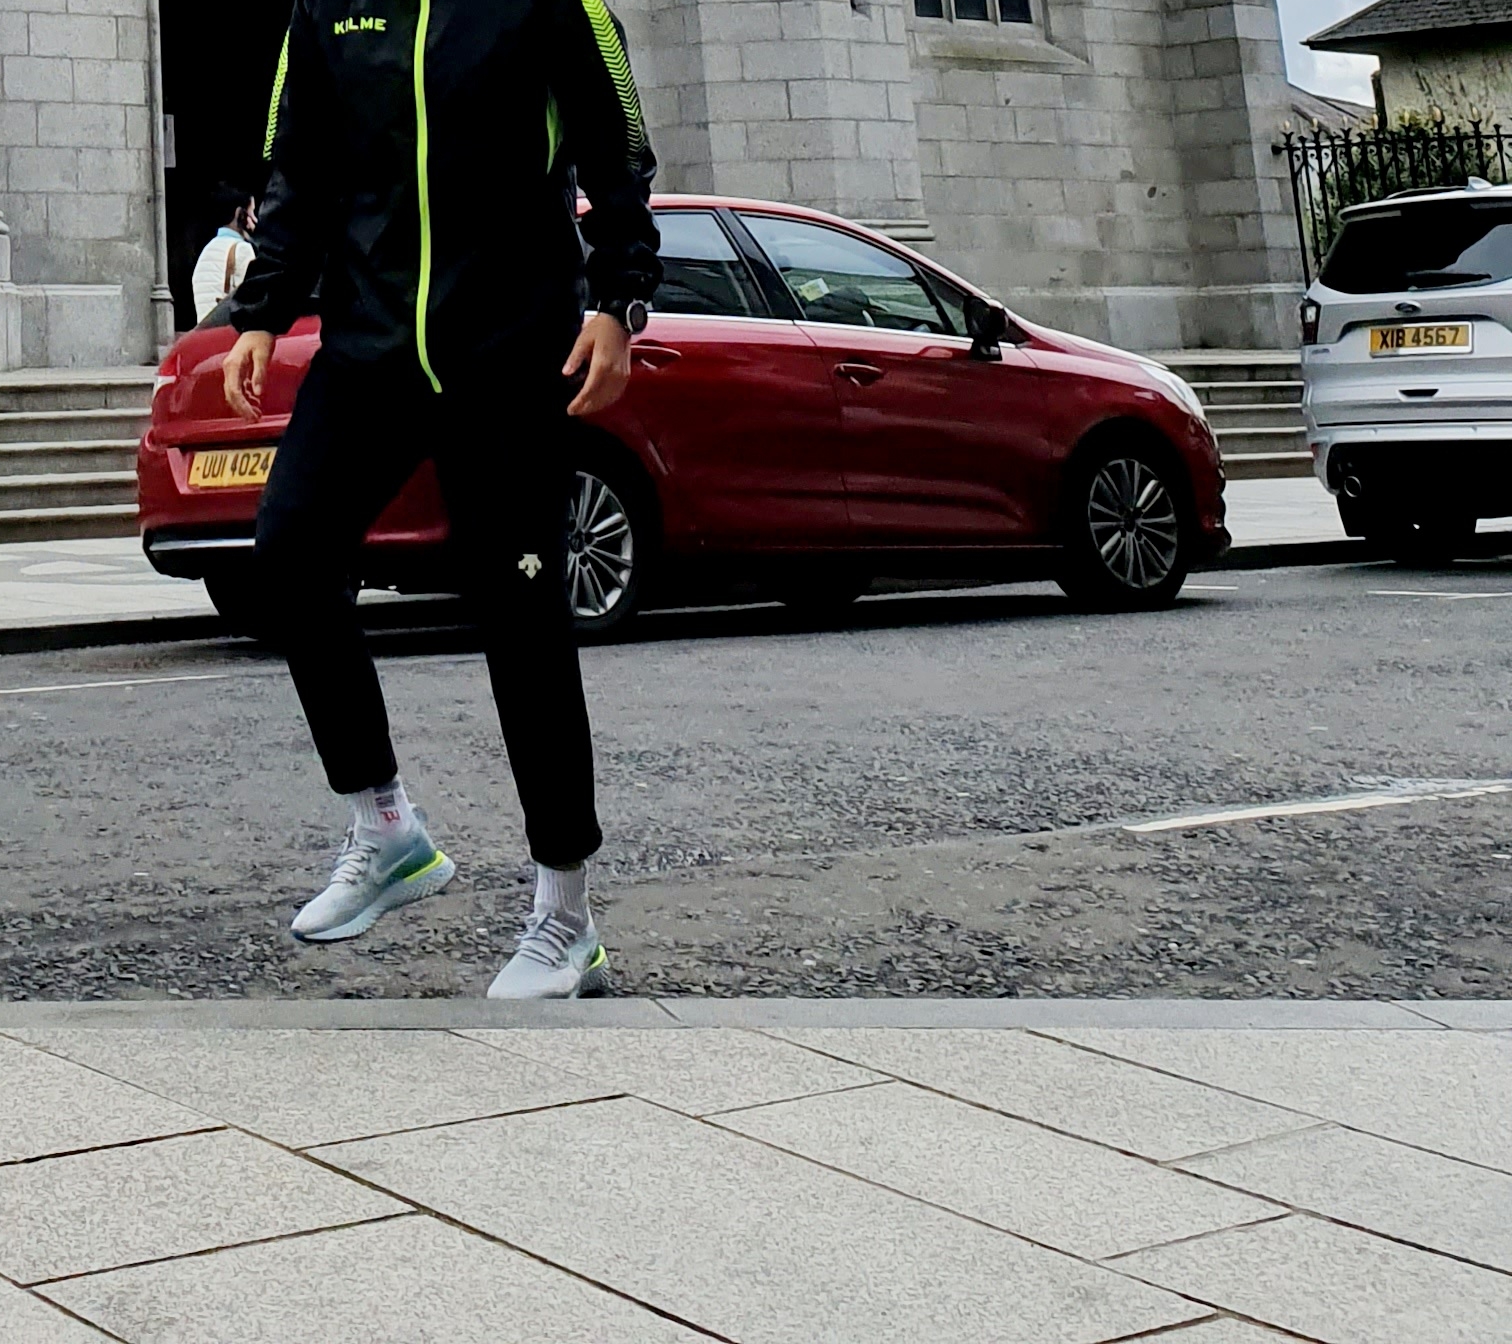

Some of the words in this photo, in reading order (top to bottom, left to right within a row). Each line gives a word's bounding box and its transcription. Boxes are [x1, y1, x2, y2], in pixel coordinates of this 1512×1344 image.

[1379, 328, 1406, 349] XIB
[1410, 327, 1460, 346] 4567
[230, 452, 271, 477] 4024
